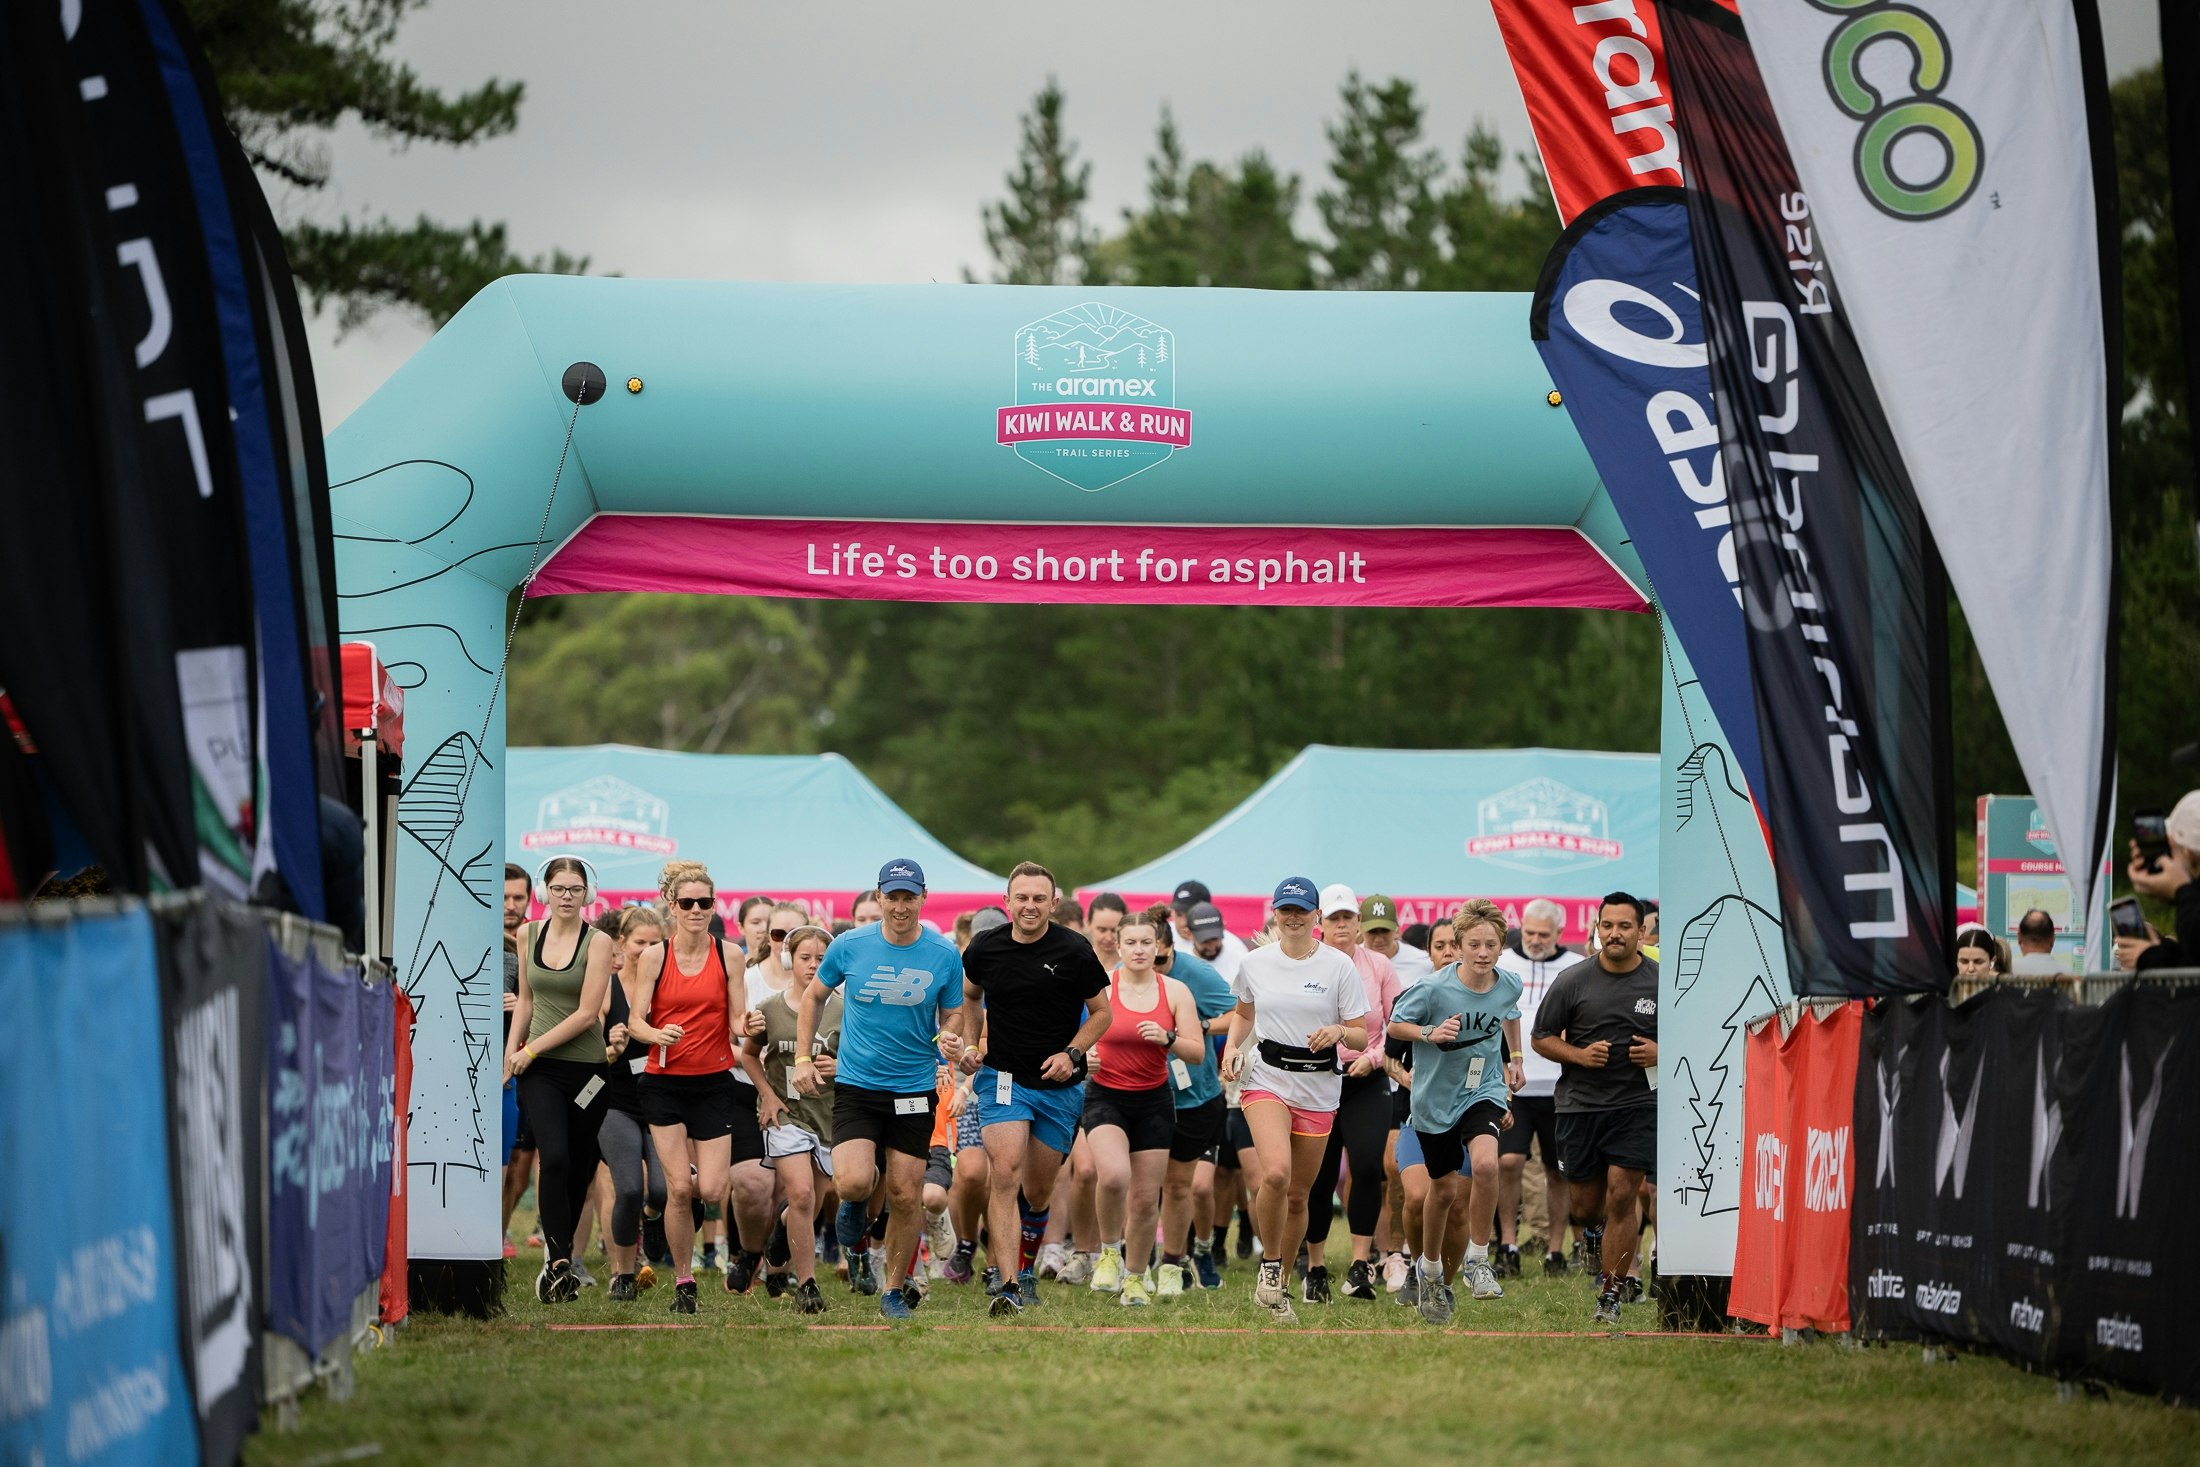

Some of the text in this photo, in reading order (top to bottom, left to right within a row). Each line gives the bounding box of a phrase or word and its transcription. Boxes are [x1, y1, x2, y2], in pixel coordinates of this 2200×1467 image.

[1032, 377, 1156, 396] THE aramex
[1005, 411, 1185, 437] KIWI WALK & RUN
[1056, 448, 1130, 458] TRAIL SERIES
[806, 543, 1366, 591] Life's too short for asphalt
[2021, 861, 2054, 872] COURSE
[1449, 1011, 1500, 1034] IKE
[779, 1040, 822, 1056] PUA
[999, 1084, 1010, 1092] 247
